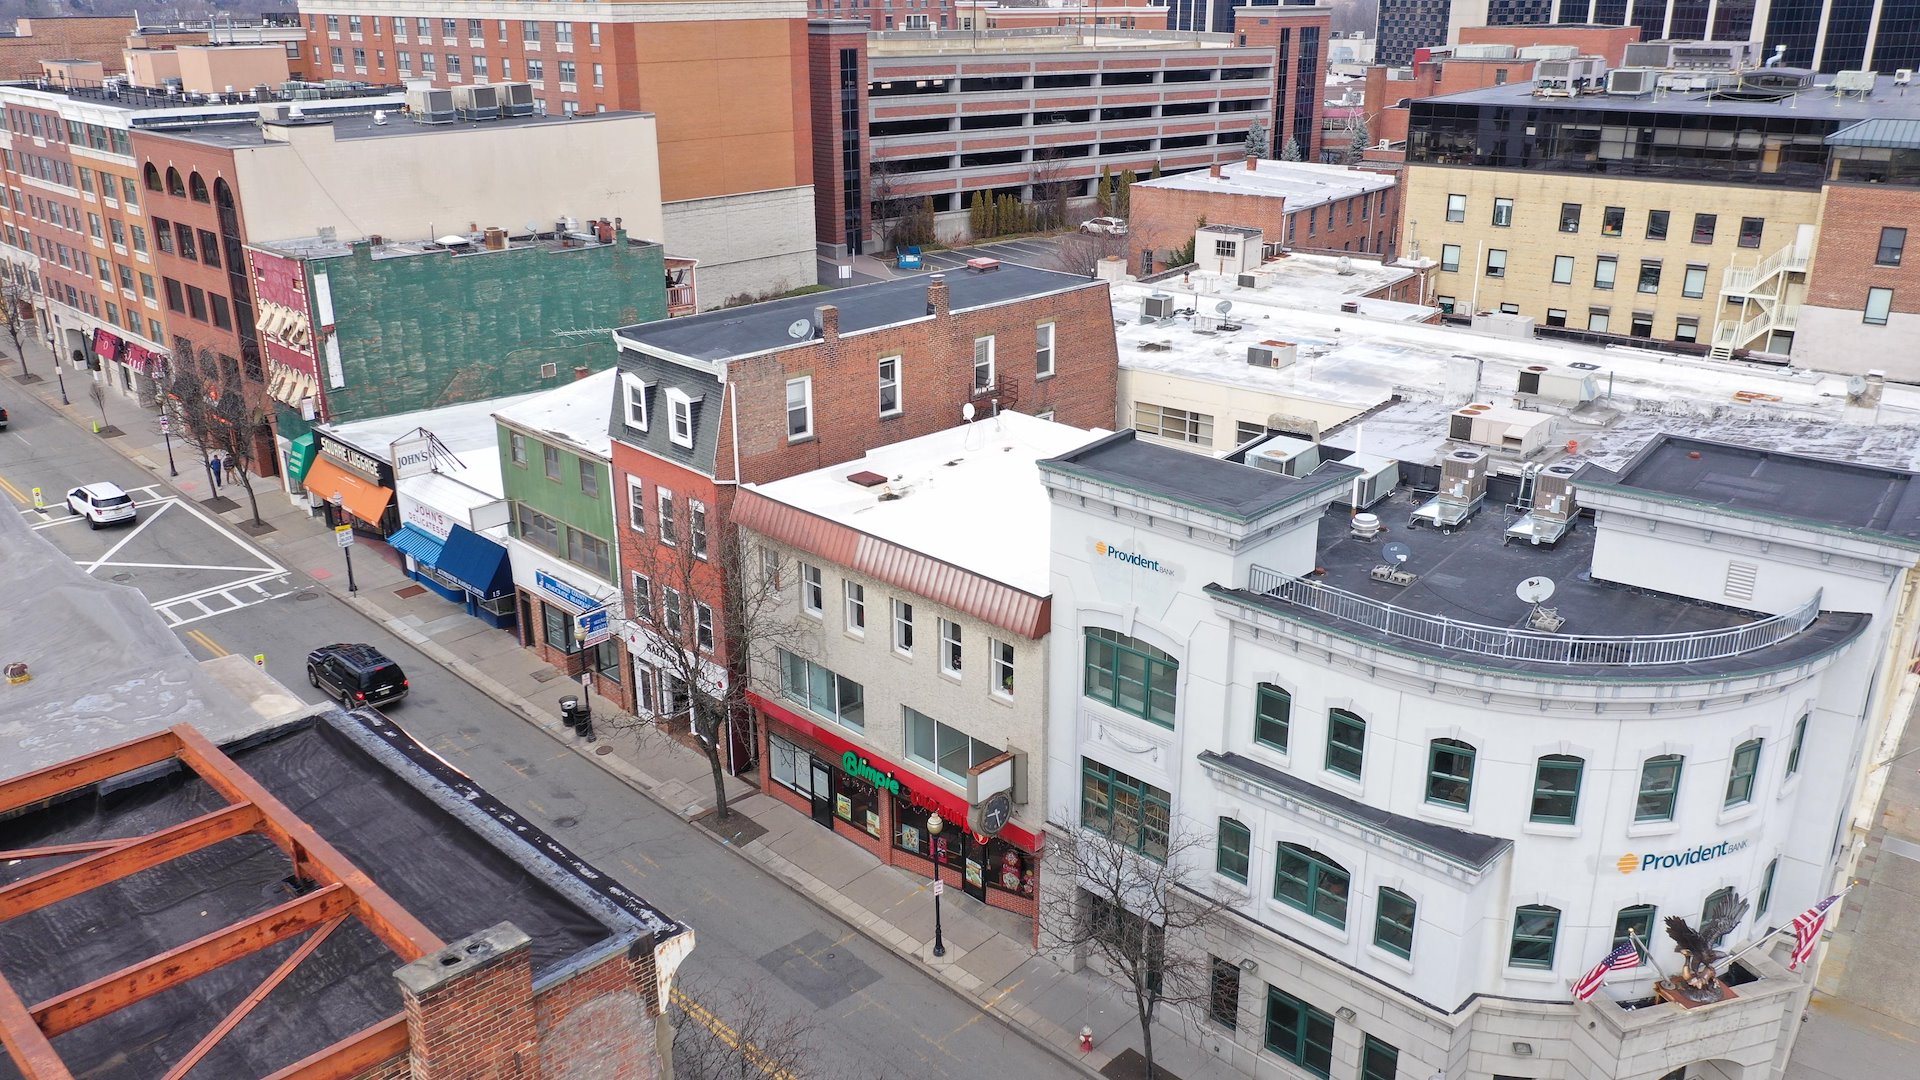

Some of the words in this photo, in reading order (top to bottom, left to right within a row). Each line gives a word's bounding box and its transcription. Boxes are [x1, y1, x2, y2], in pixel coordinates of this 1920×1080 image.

[320, 436, 348, 462] SQUARE
[347, 448, 380, 477] LUGGAGE
[397, 450, 428, 470] JOHN'S
[408, 511, 448, 537] DELICATESSE
[415, 504, 444, 525] JOHN'S
[1108, 545, 1160, 572] Provident
[1159, 566, 1175, 577] BANK
[842, 750, 900, 796] Blimpie
[1641, 840, 1729, 871] Provident
[1728, 839, 1749, 854] BANK
